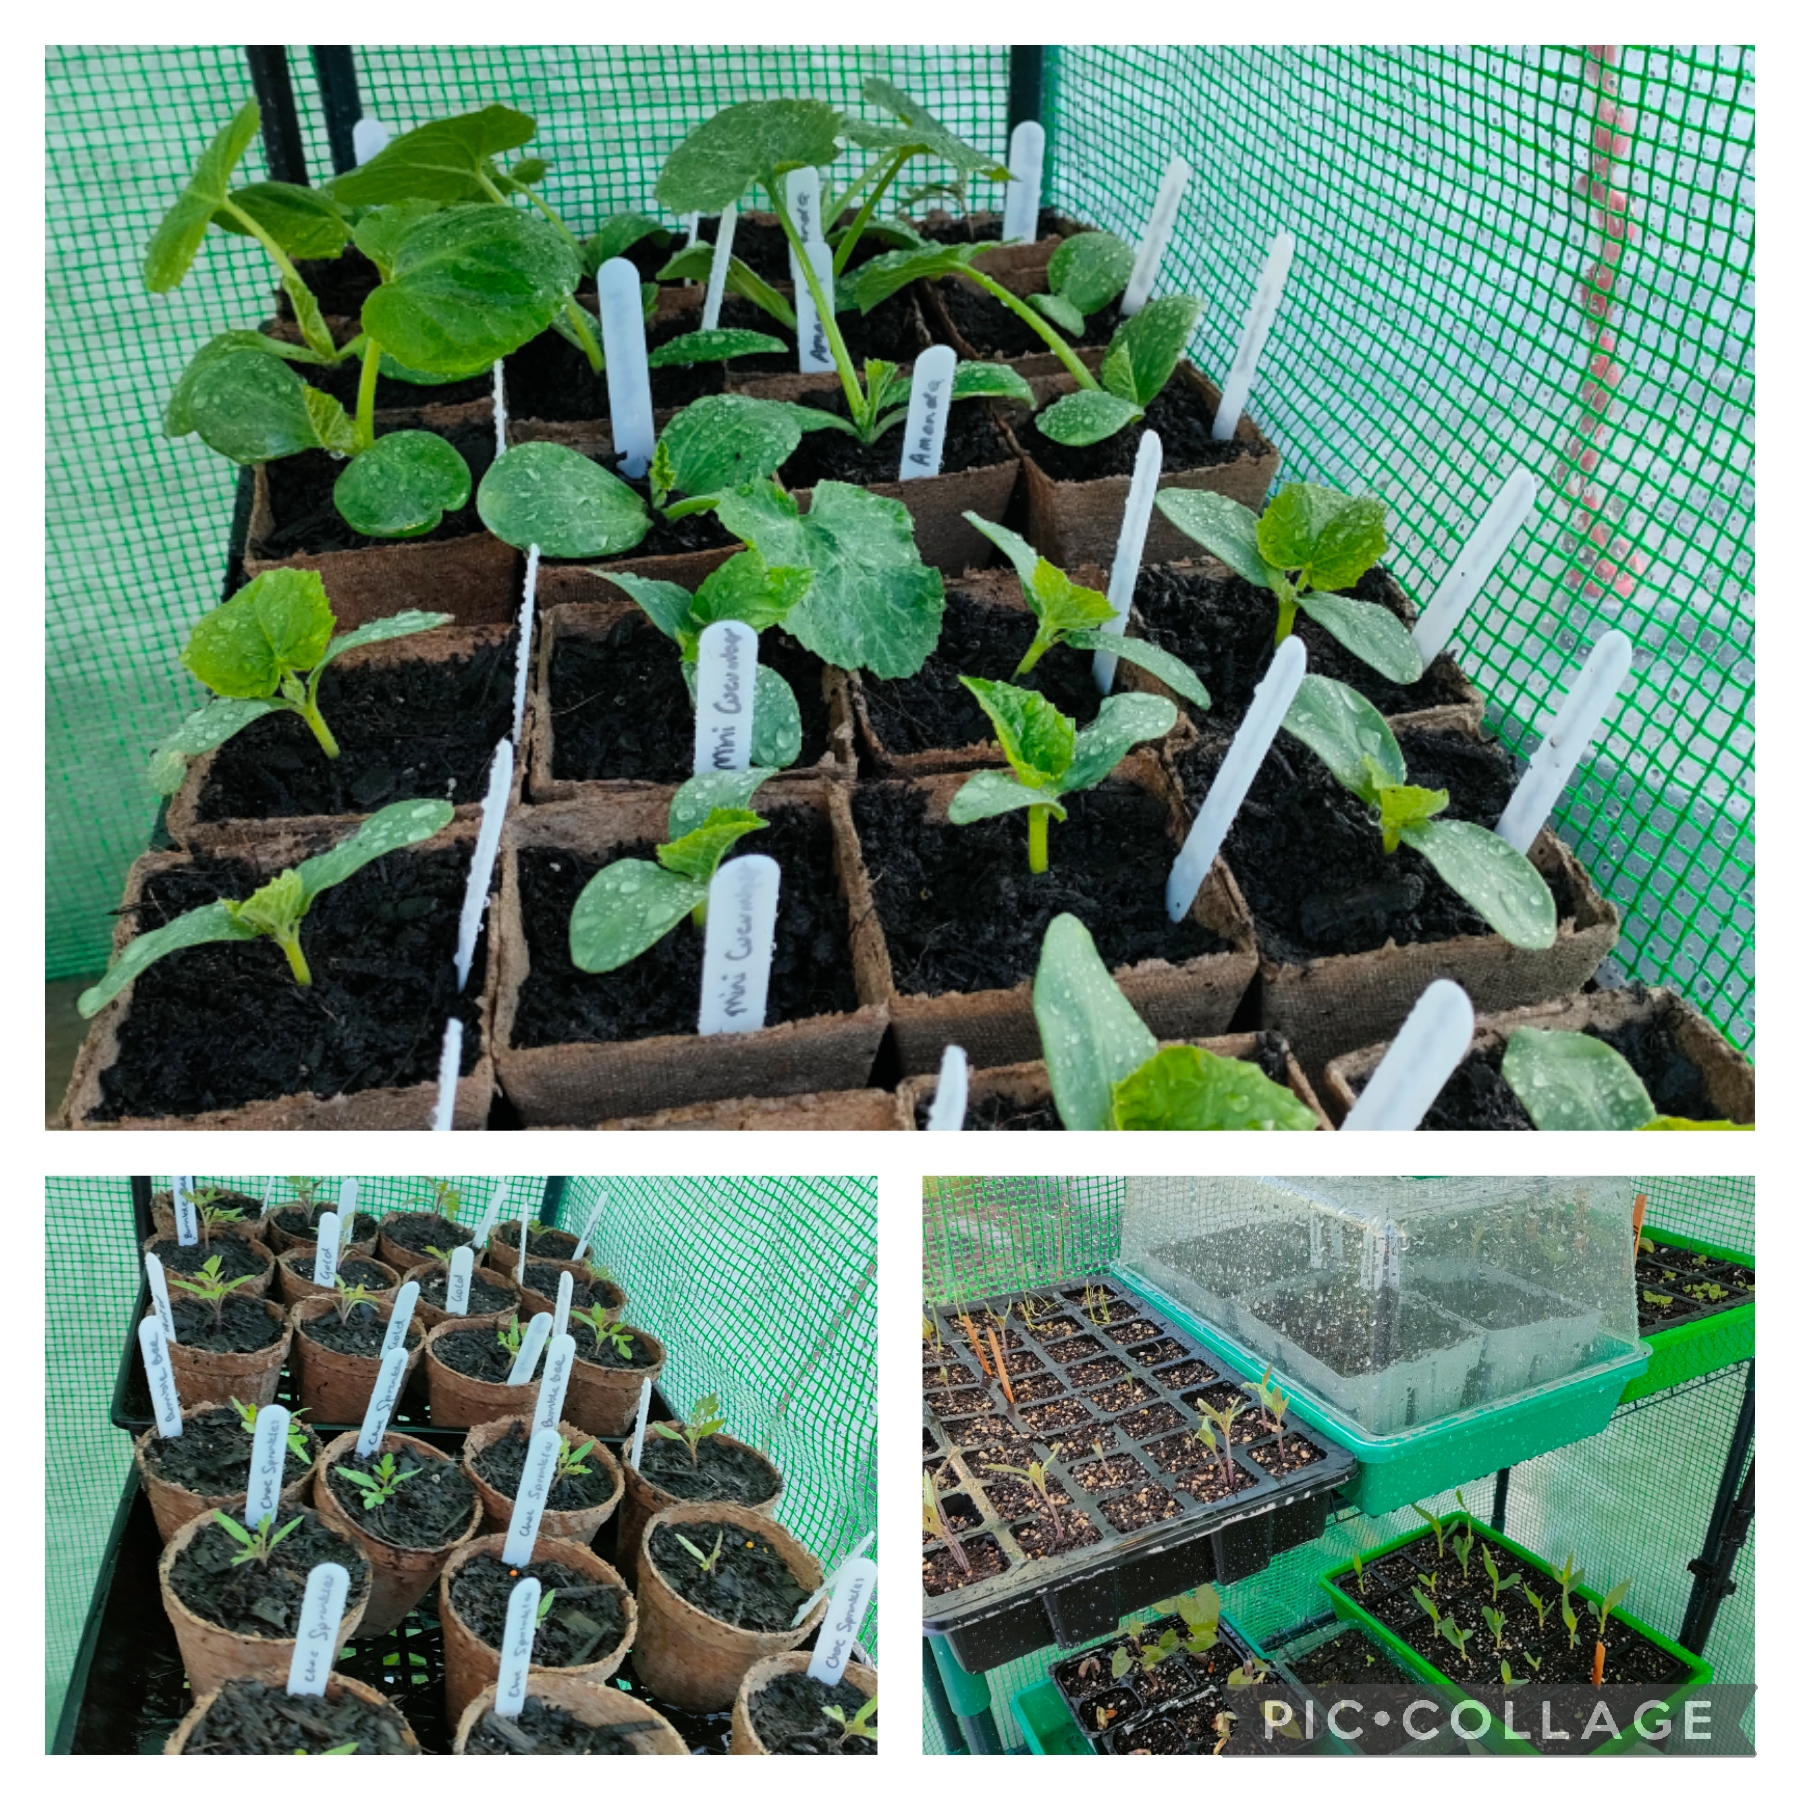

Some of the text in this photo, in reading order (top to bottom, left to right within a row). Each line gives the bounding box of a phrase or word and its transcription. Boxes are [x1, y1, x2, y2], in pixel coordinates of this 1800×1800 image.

[908, 378, 944, 467] Amanda
[711, 725, 738, 770] Mini
[717, 972, 748, 1017] Mini
[319, 1247, 332, 1280] Gold
[451, 1274, 463, 1303] Gold
[387, 1318, 405, 1350] Gold
[159, 1368, 176, 1422] Bumble
[540, 1386, 560, 1428] Bumble
[260, 1478, 274, 1511] Choc
[519, 1510, 534, 1538] Choc
[304, 1650, 319, 1682] Choc
[825, 1639, 846, 1669] Choc
